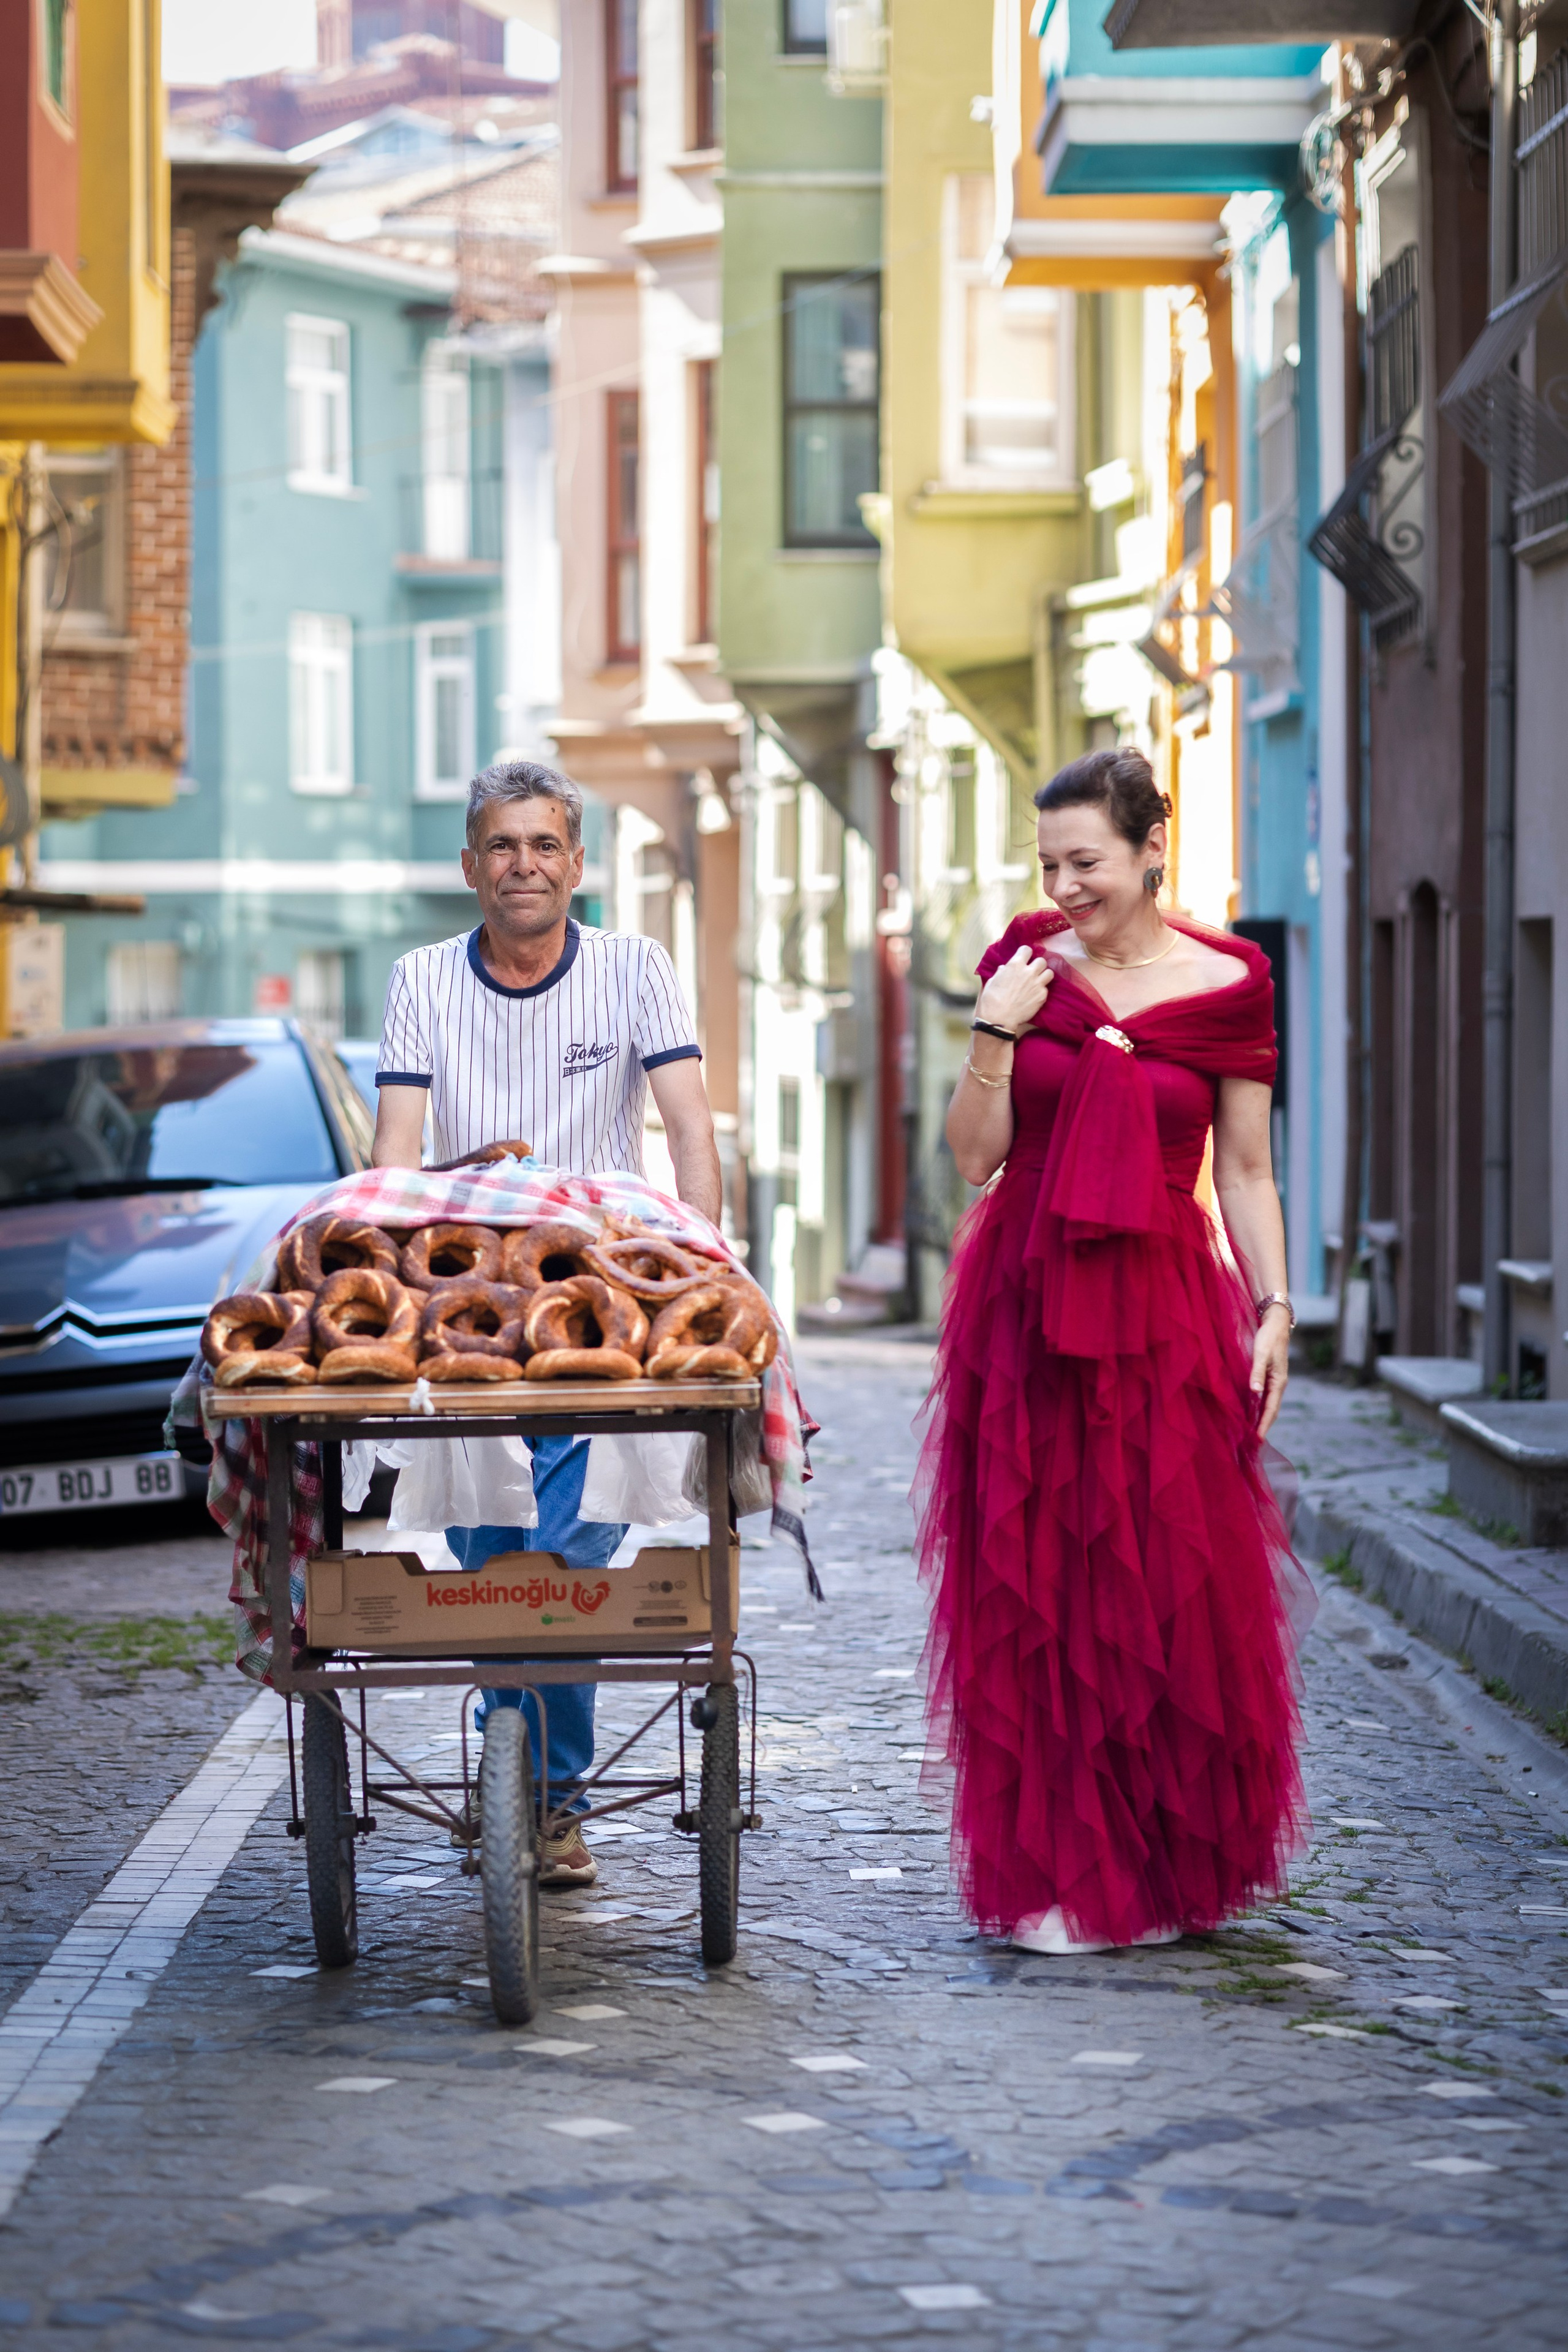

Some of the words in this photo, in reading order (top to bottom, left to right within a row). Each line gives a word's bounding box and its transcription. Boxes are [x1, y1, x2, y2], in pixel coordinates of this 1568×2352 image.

[564, 1042, 618, 1063] Tokyo
[2, 1474, 34, 1507] 07
[58, 1466, 113, 1503] BDJ
[136, 1462, 172, 1495] 88
[426, 1577, 567, 1609] keskinoğlu
